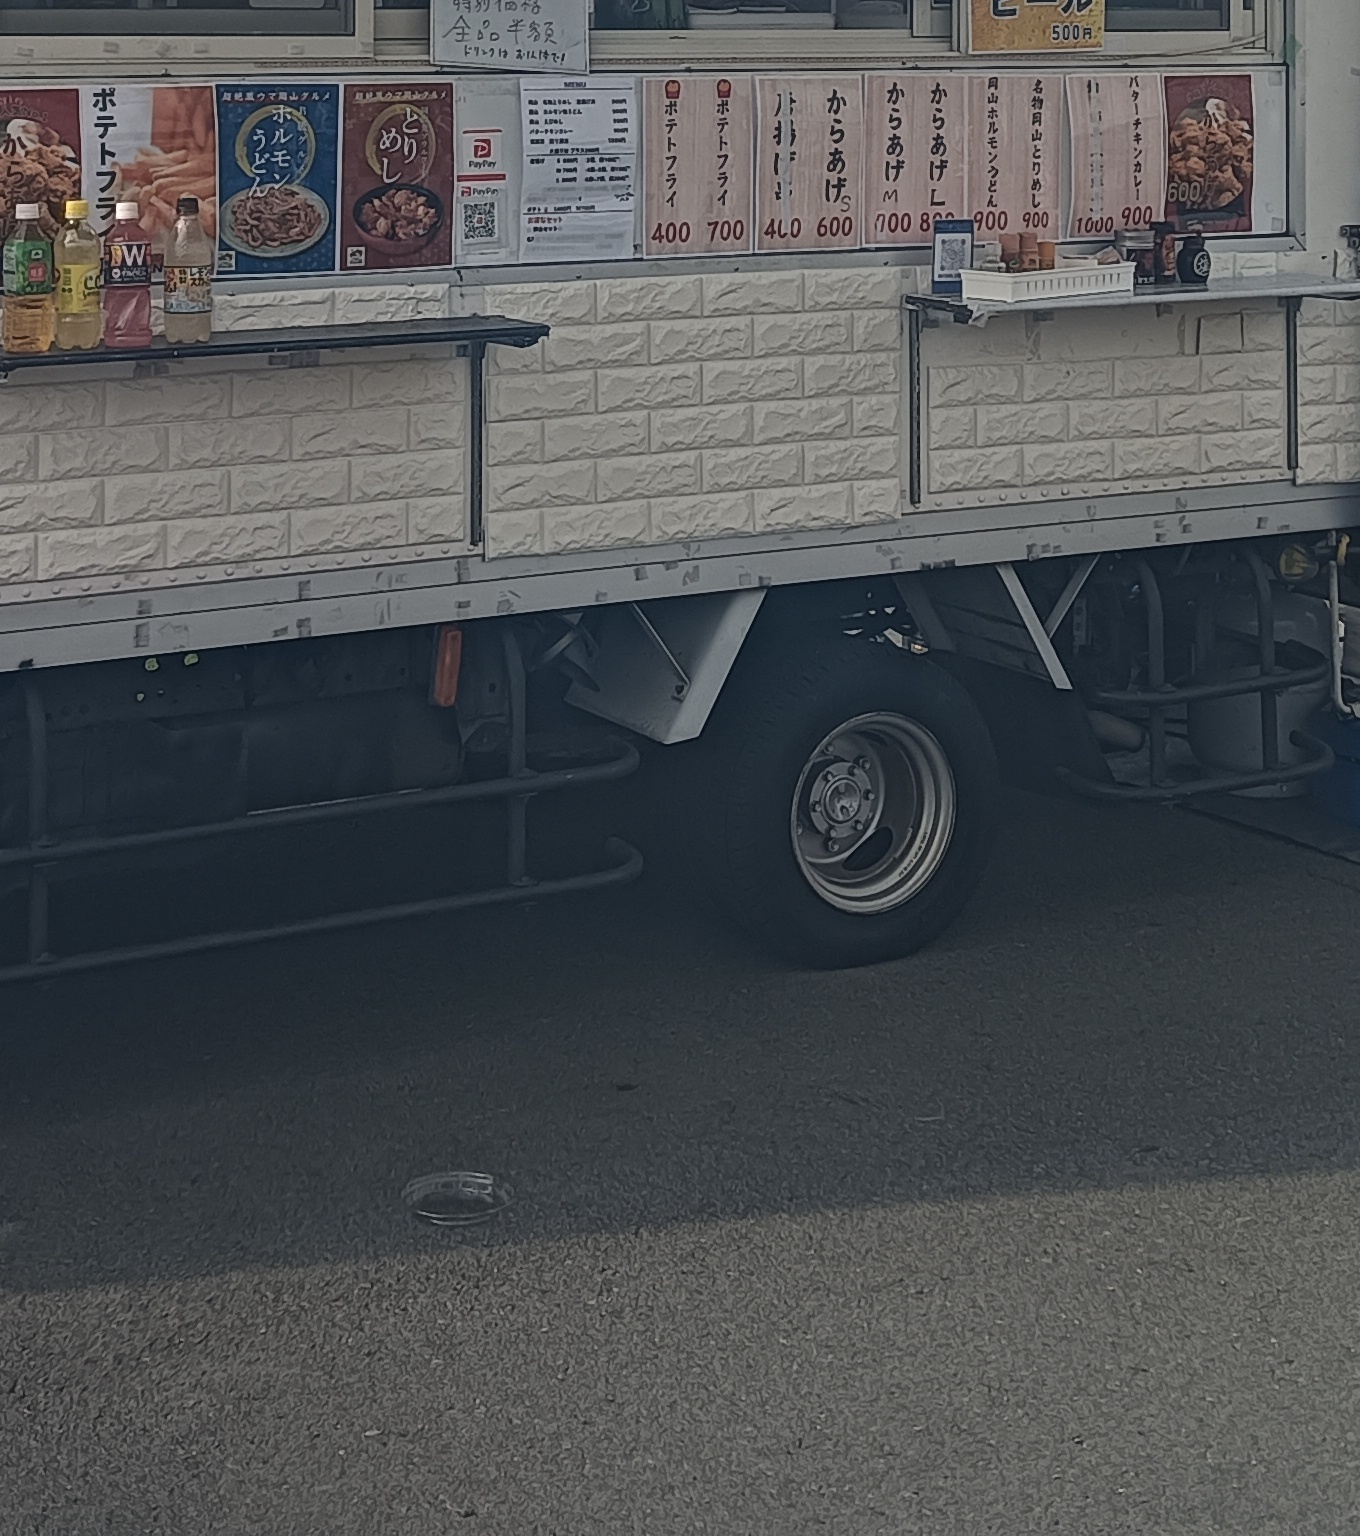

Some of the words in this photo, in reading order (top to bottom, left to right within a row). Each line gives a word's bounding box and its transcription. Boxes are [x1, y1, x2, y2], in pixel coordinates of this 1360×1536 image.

[1051, 23, 1093, 42] 500円
[401, 107, 419, 164] とり
[885, 81, 906, 183] からあげ
[929, 81, 948, 182] からあげ
[987, 76, 1000, 208] 岡山ホルモンうどん
[1129, 75, 1143, 201] バターチキンカレー
[271, 105, 294, 190] ホルモン
[379, 128, 403, 184] めし
[664, 100, 679, 207] ポテトフライ
[716, 100, 731, 206] ポテトフライ
[825, 89, 848, 204] からあげ
[248, 128, 271, 199] うどん
[468, 159, 497, 170] PayPay
[472, 187, 499, 197] PayPay
[883, 189, 898, 203] M
[930, 189, 946, 206] L
[1167, 181, 1200, 203] 600
[874, 212, 912, 234] 700
[973, 210, 1008, 232] 900
[1022, 211, 1049, 229] 900
[1076, 216, 1114, 234] 1000
[1121, 205, 1153, 226] 900
[651, 221, 691, 243] 400
[707, 219, 745, 242] 700
[816, 216, 853, 238] 600
